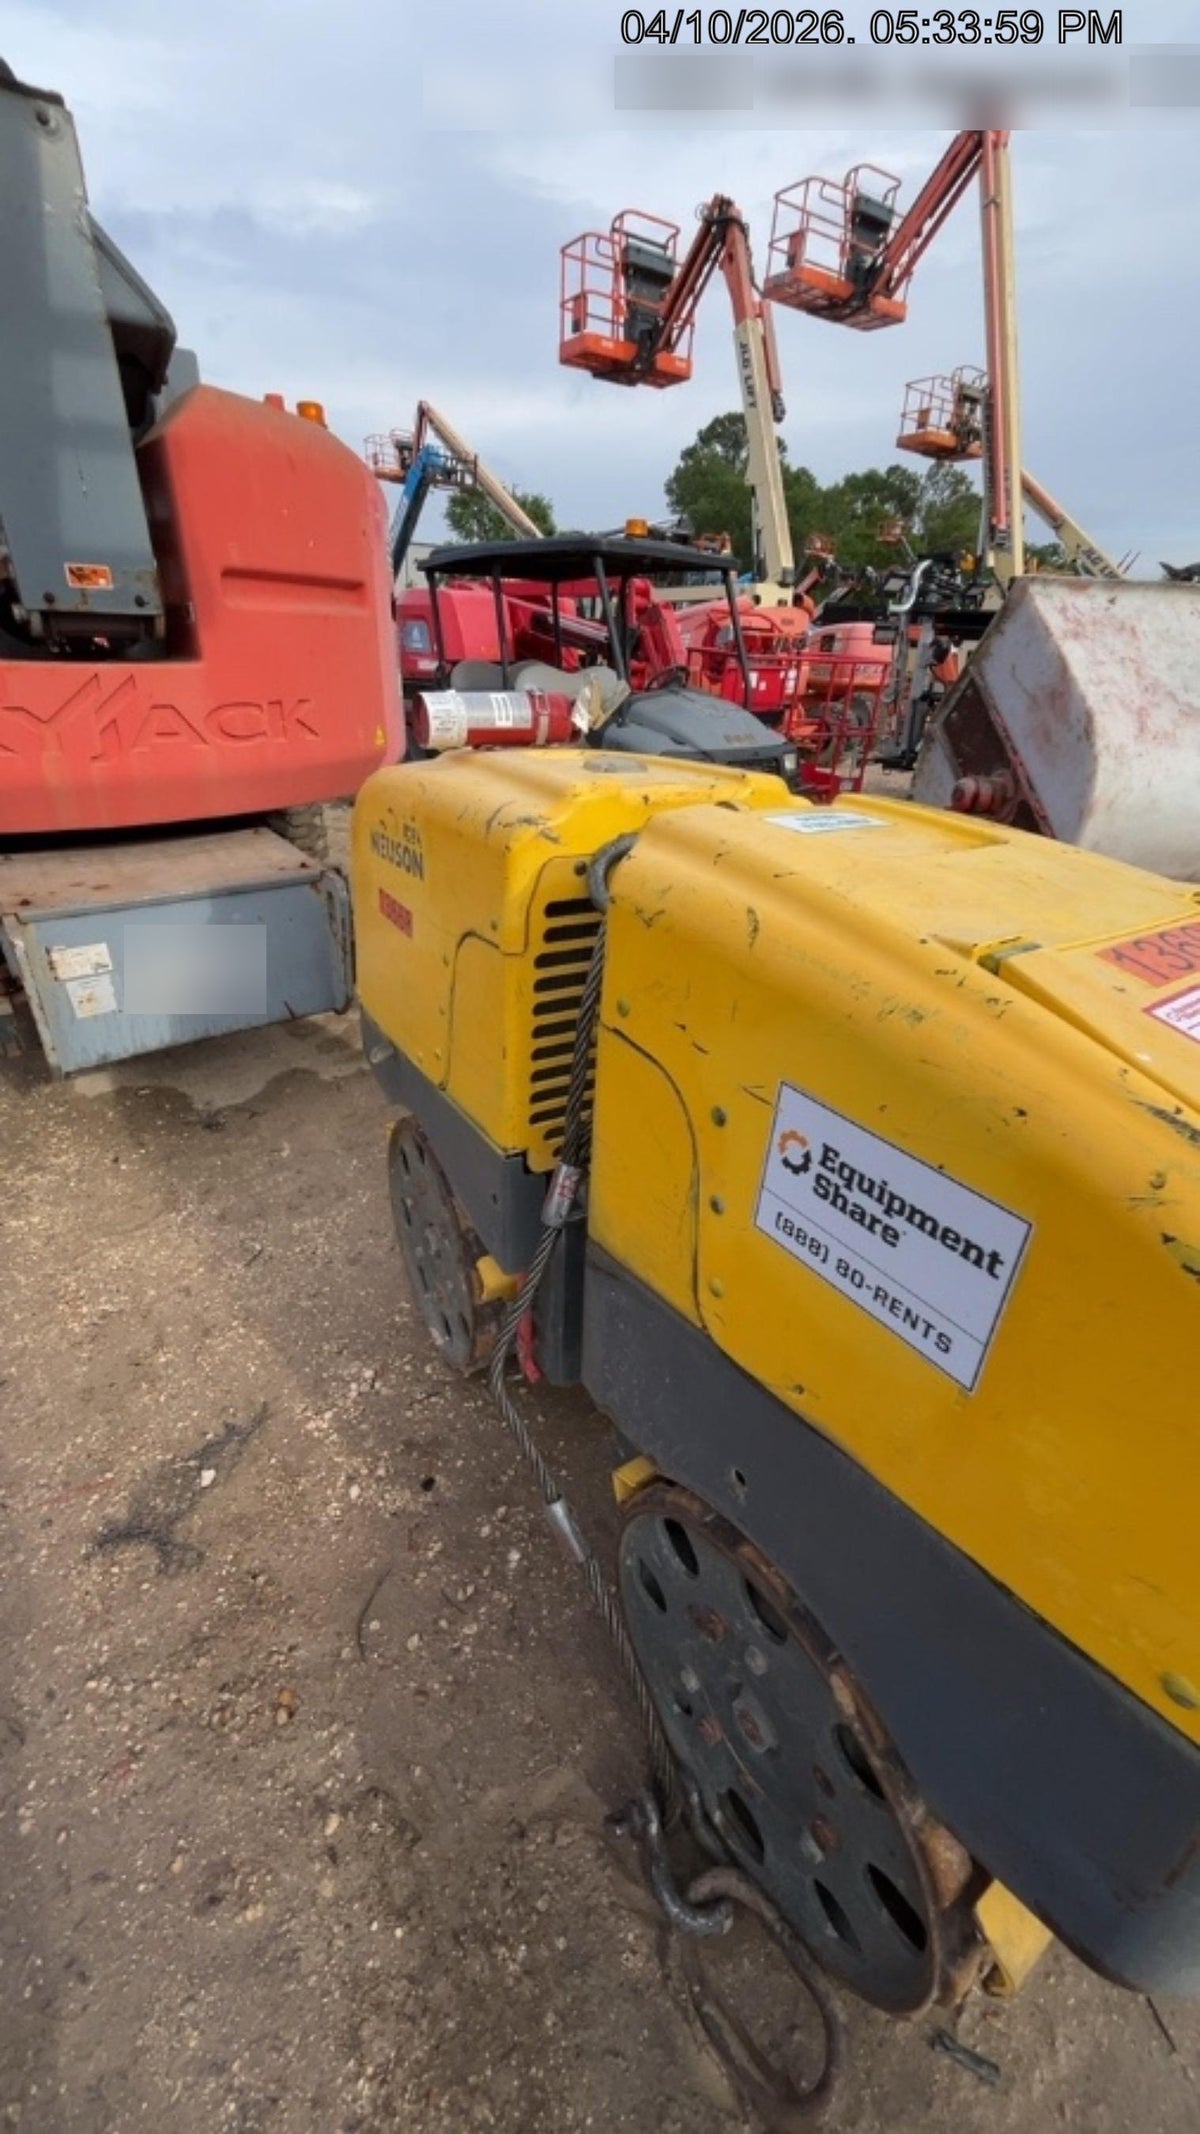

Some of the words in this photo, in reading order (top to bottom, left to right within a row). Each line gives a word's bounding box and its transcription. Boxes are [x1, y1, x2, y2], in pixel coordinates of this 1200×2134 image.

[812, 1173, 901, 1248] Share
[818, 1142, 1005, 1280] Equipment
[774, 1211, 830, 1264] (888)
[836, 1258, 953, 1354] 80-RENTS
